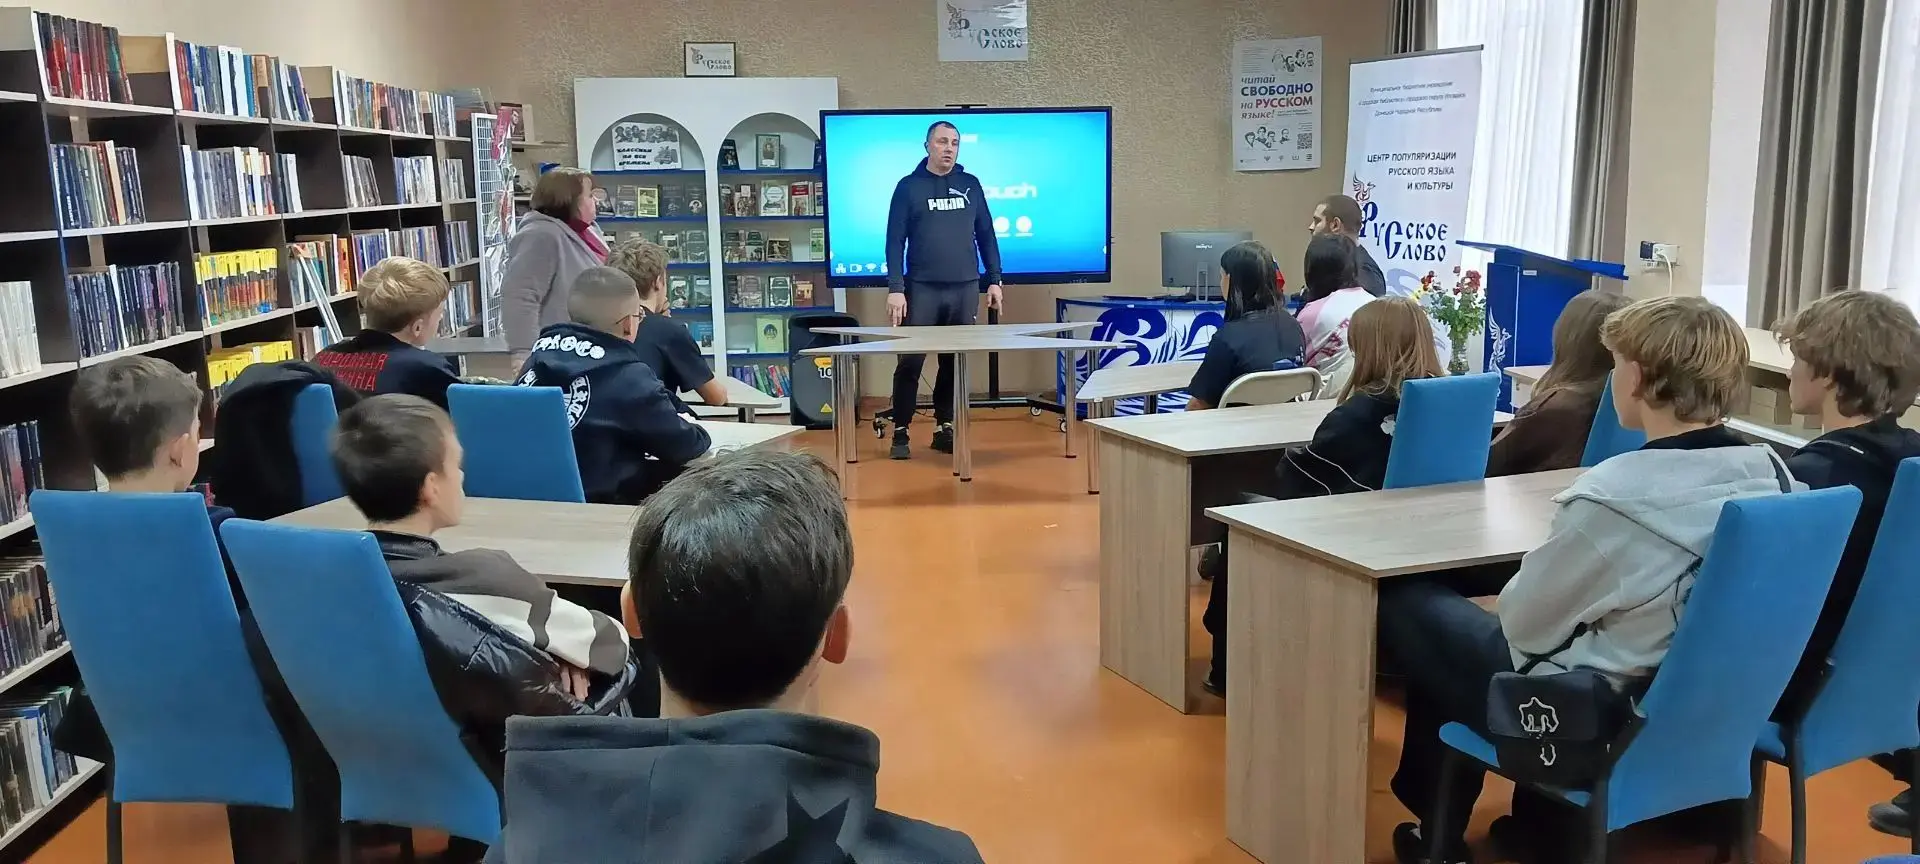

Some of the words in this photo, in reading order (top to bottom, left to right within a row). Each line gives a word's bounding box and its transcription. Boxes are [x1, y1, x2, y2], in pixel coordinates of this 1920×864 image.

[1241, 75, 1276, 84] читай
[1241, 83, 1314, 97] СВОБОДНО
[1256, 96, 1313, 108] РУССКОМ
[1367, 154, 1390, 163] ЦЕНТР
[1392, 152, 1457, 162] ПОПУЛЯРИЗАЦИИ
[1388, 167, 1426, 176] РУССКОГО
[1427, 167, 1455, 175] ЯЗЫКА
[1407, 182, 1413, 190] И
[1415, 182, 1454, 190] КУЛЬТУРЫ
